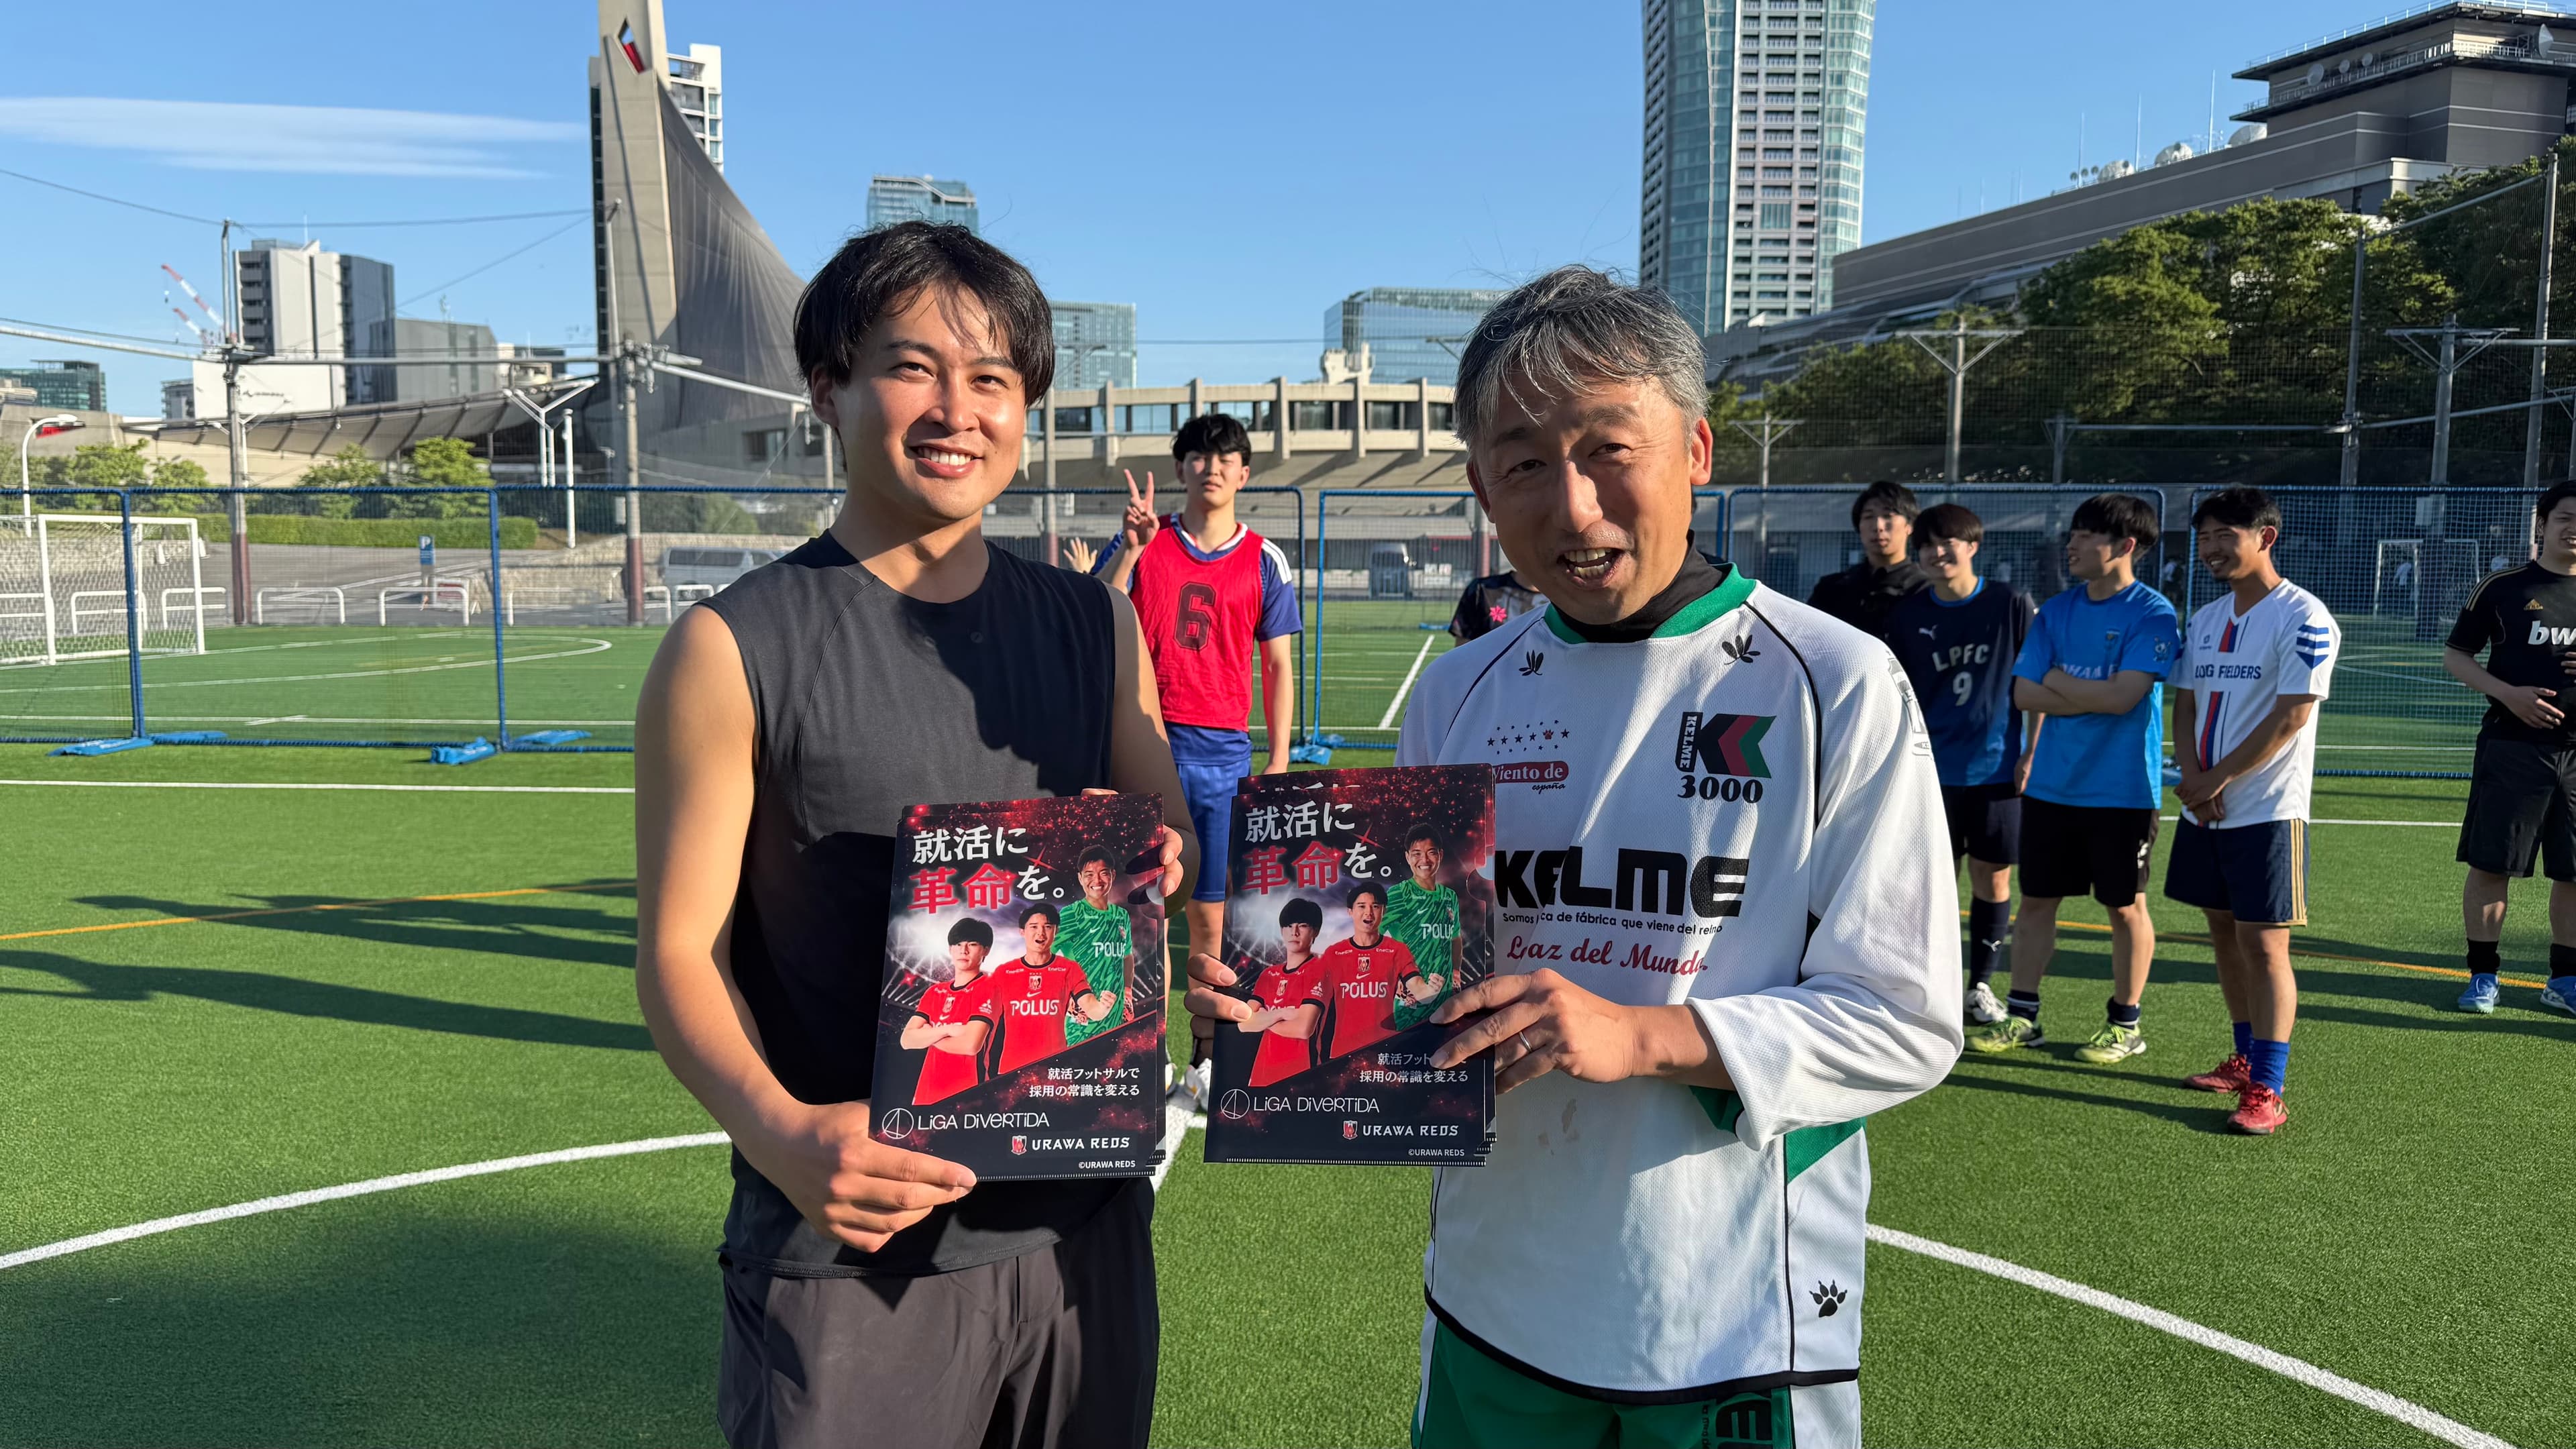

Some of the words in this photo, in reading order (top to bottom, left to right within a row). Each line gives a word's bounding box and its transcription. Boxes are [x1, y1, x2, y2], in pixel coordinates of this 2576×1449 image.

[1173, 582, 1216, 651] 6
[1933, 643, 1989, 672] LPFC
[1953, 672, 1972, 706] 9
[1679, 715, 1697, 768] KELME
[1492, 765, 1540, 780] Viento
[1544, 763, 1563, 778] de
[1532, 783, 1566, 794] españa
[1678, 775, 1763, 804] 3000
[1245, 800, 1355, 843] 就活に
[912, 824, 1028, 864] 就活に
[1241, 841, 1392, 895] 革命を。
[907, 863, 1065, 914] 革命を。
[1495, 846, 1750, 918] KELME
[1503, 913, 1534, 924] Somos
[1557, 912, 1572, 922] de
[1576, 911, 1616, 926] fábrica
[1621, 919, 1643, 929] que
[1647, 920, 1674, 932] viene
[1677, 923, 1696, 934] del
[1699, 924, 1723, 934] reino
[1570, 938, 1613, 965] del
[1340, 981, 1388, 999] POLUS
[1010, 1000, 1059, 1016] POLUS
[1377, 1053, 1466, 1065] 就活フット
[1048, 1067, 1140, 1080] 就活フットサルで
[1359, 1070, 1468, 1083] 採用の常識を変える
[1029, 1084, 1140, 1097] 採用の常識を変える
[1362, 1125, 1413, 1136] URAWA
[1420, 1125, 1459, 1136] REDS
[1032, 1138, 1084, 1150] URAWA
[1091, 1137, 1130, 1148] REDS
[1444, 1148, 1465, 1157] REDS
[1115, 1160, 1136, 1169] REDS
